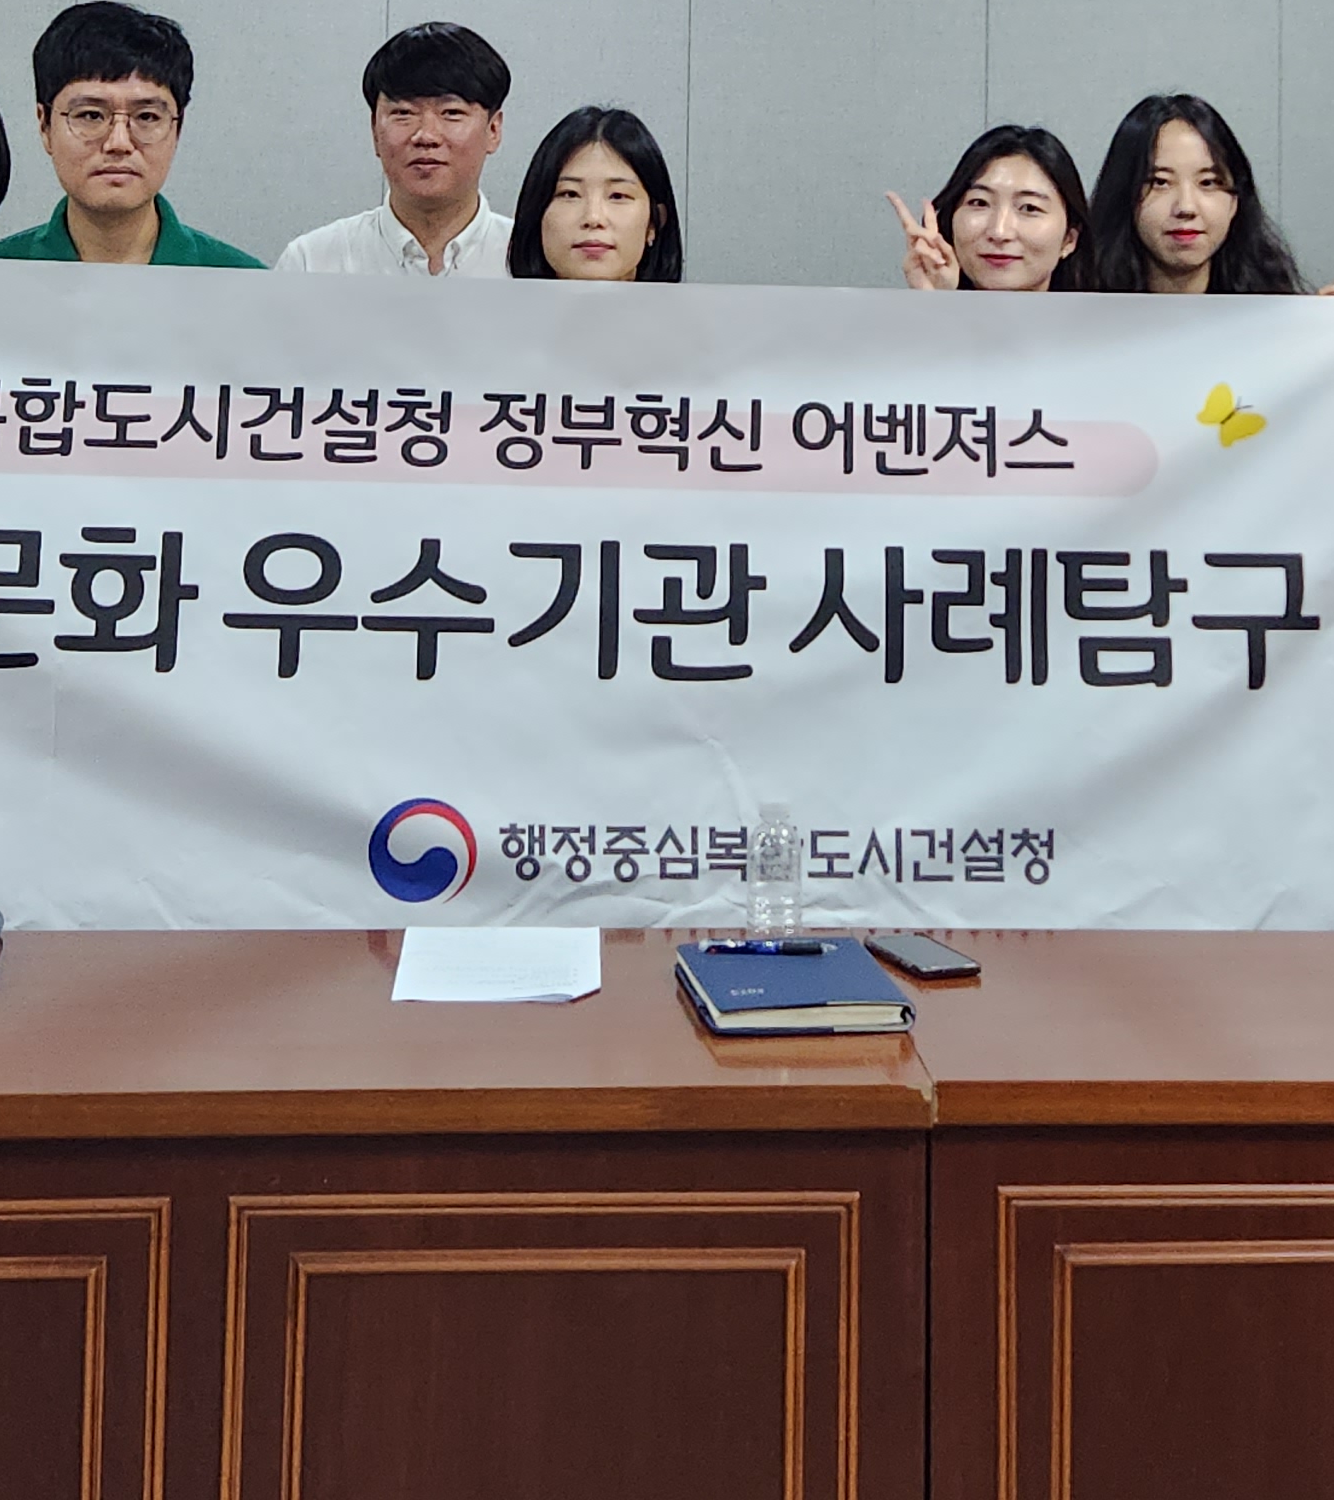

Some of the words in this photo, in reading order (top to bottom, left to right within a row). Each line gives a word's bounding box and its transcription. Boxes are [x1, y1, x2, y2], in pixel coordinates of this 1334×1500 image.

[478, 392, 764, 474] 정부혁신
[791, 401, 1076, 479] 어벤져스
[221, 531, 768, 683] 우수기관
[787, 545, 1322, 692] 사례탐구
[498, 822, 1056, 886] 행정중심복도시건설청
